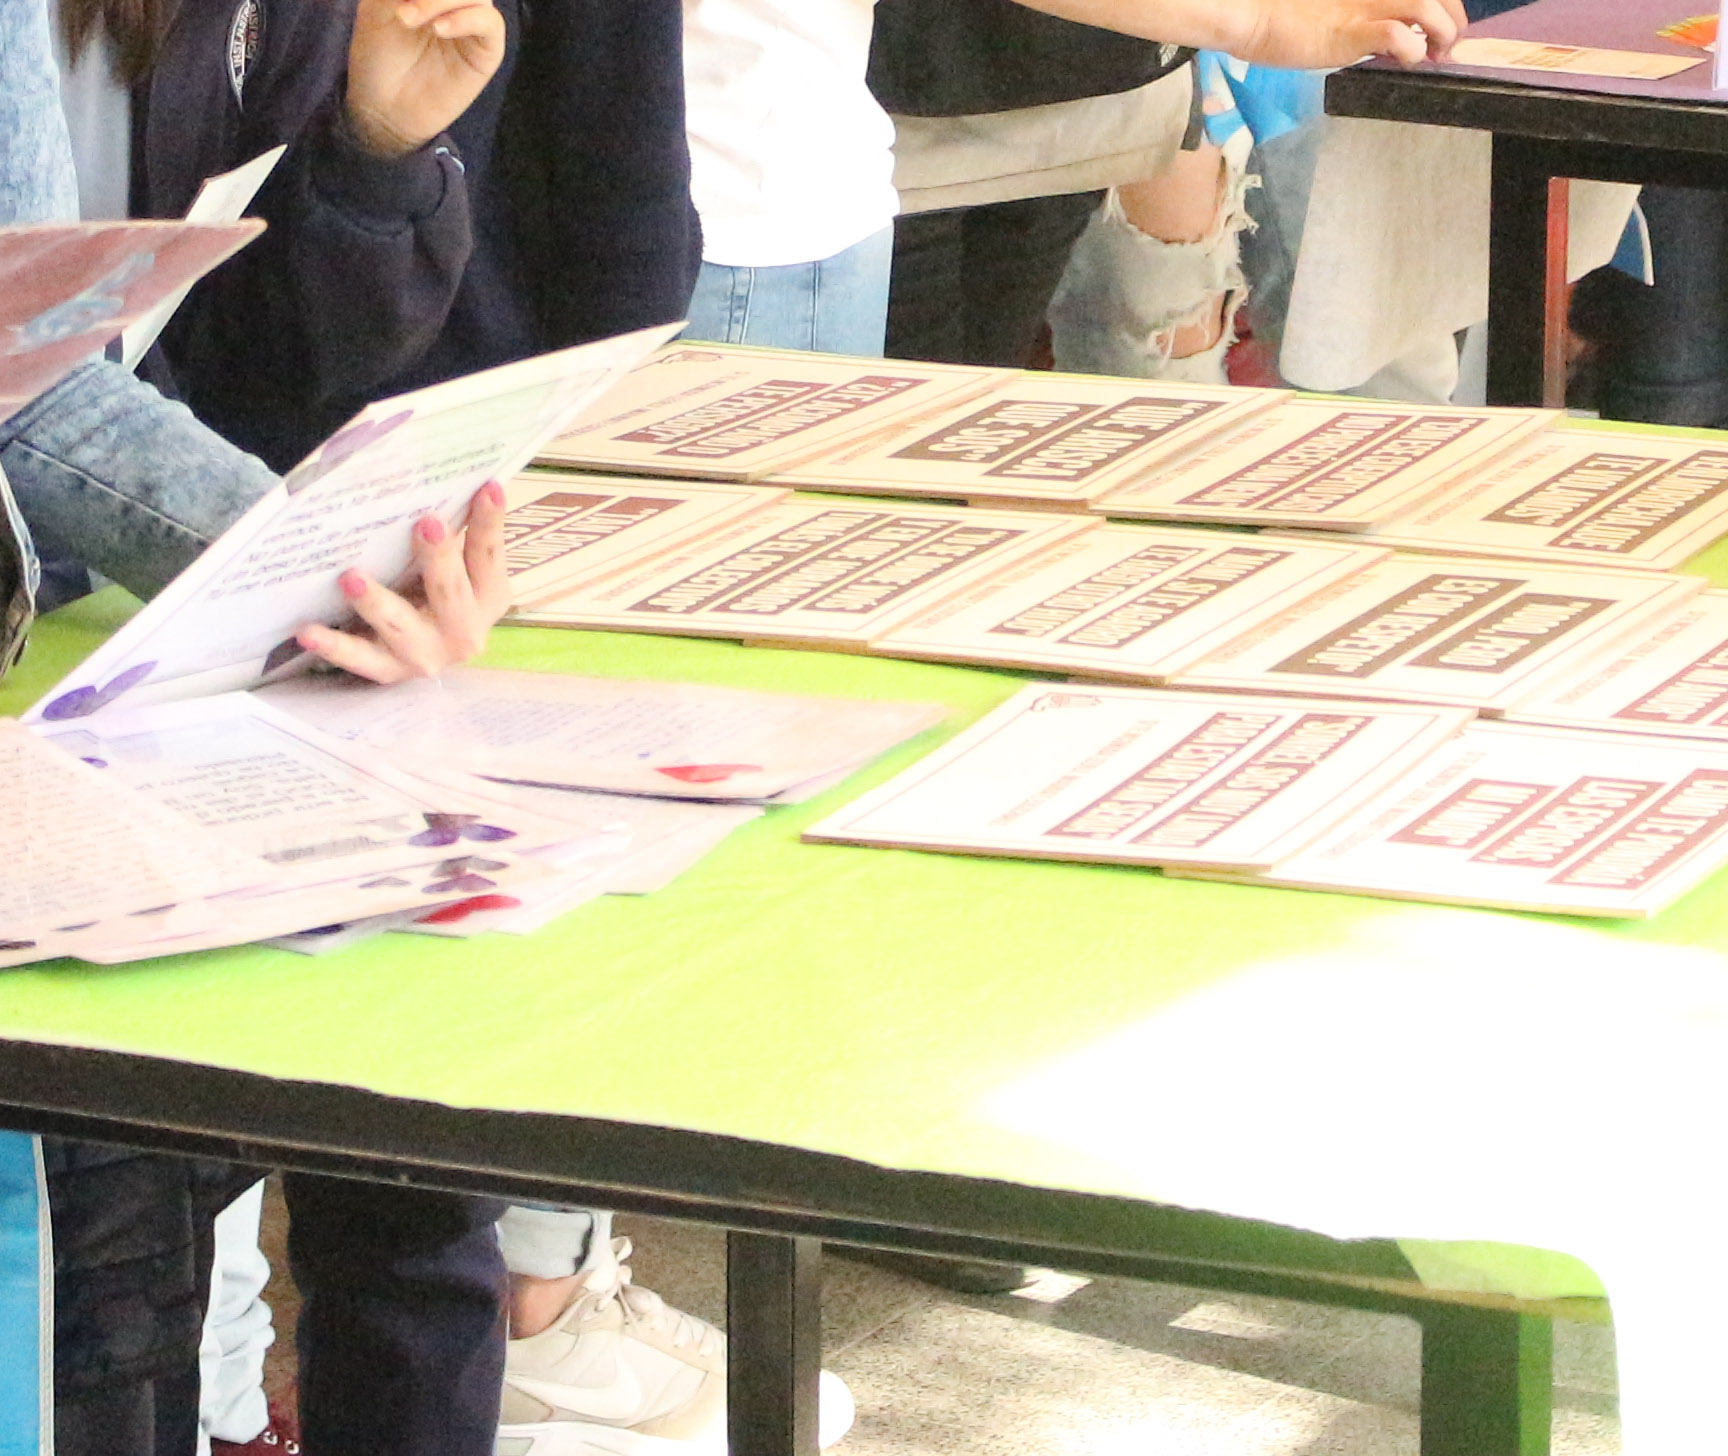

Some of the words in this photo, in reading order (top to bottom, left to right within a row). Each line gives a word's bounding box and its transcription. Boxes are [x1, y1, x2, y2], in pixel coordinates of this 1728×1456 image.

[741, 384, 812, 397] TE
[635, 396, 779, 441] PERSIGO?"
[691, 399, 858, 448] ACOMPAÑO
[974, 402, 1082, 427] QUE
[1331, 414, 1397, 428] NO
[670, 445, 729, 454] O
[997, 428, 1148, 476] ARISCA
[1369, 439, 1442, 456] ESE
[1234, 464, 1310, 481] UNA
[1582, 456, 1656, 470] TE
[1301, 456, 1415, 494] CUERPITO
[502, 504, 583, 525] TAN
[896, 519, 949, 528] Y
[775, 512, 874, 541] TOMÁS
[866, 526, 932, 541] EN
[1557, 526, 1641, 550] QUE
[747, 540, 811, 552] EL
[824, 540, 906, 560] QUE
[915, 543, 978, 556] SE
[1137, 547, 1199, 560] TE
[1088, 558, 1176, 585] HAGO
[723, 559, 864, 612] HORARIOS
[1039, 582, 1128, 610] OTRO
[1160, 580, 1220, 594] SI
[1429, 578, 1501, 594] ES
[1134, 592, 1202, 607] TE
[1391, 592, 1477, 615] CON
[1063, 604, 1175, 645] AGARRO
[1432, 635, 1533, 666] PERO
[1190, 713, 1279, 745] PARA
[1137, 744, 1239, 780] ESTAR
[1221, 765, 1303, 790] SOS
[1108, 780, 1188, 803] TAN
[1186, 788, 1270, 816] MUY
[1461, 784, 1538, 804] MI
[1563, 780, 1649, 808] LAS
[1141, 813, 1235, 846] LINDA
[1479, 805, 1615, 862] ESPOSAS,
[1632, 816, 1708, 834] TE
[1563, 832, 1686, 886] PONDRÍA
